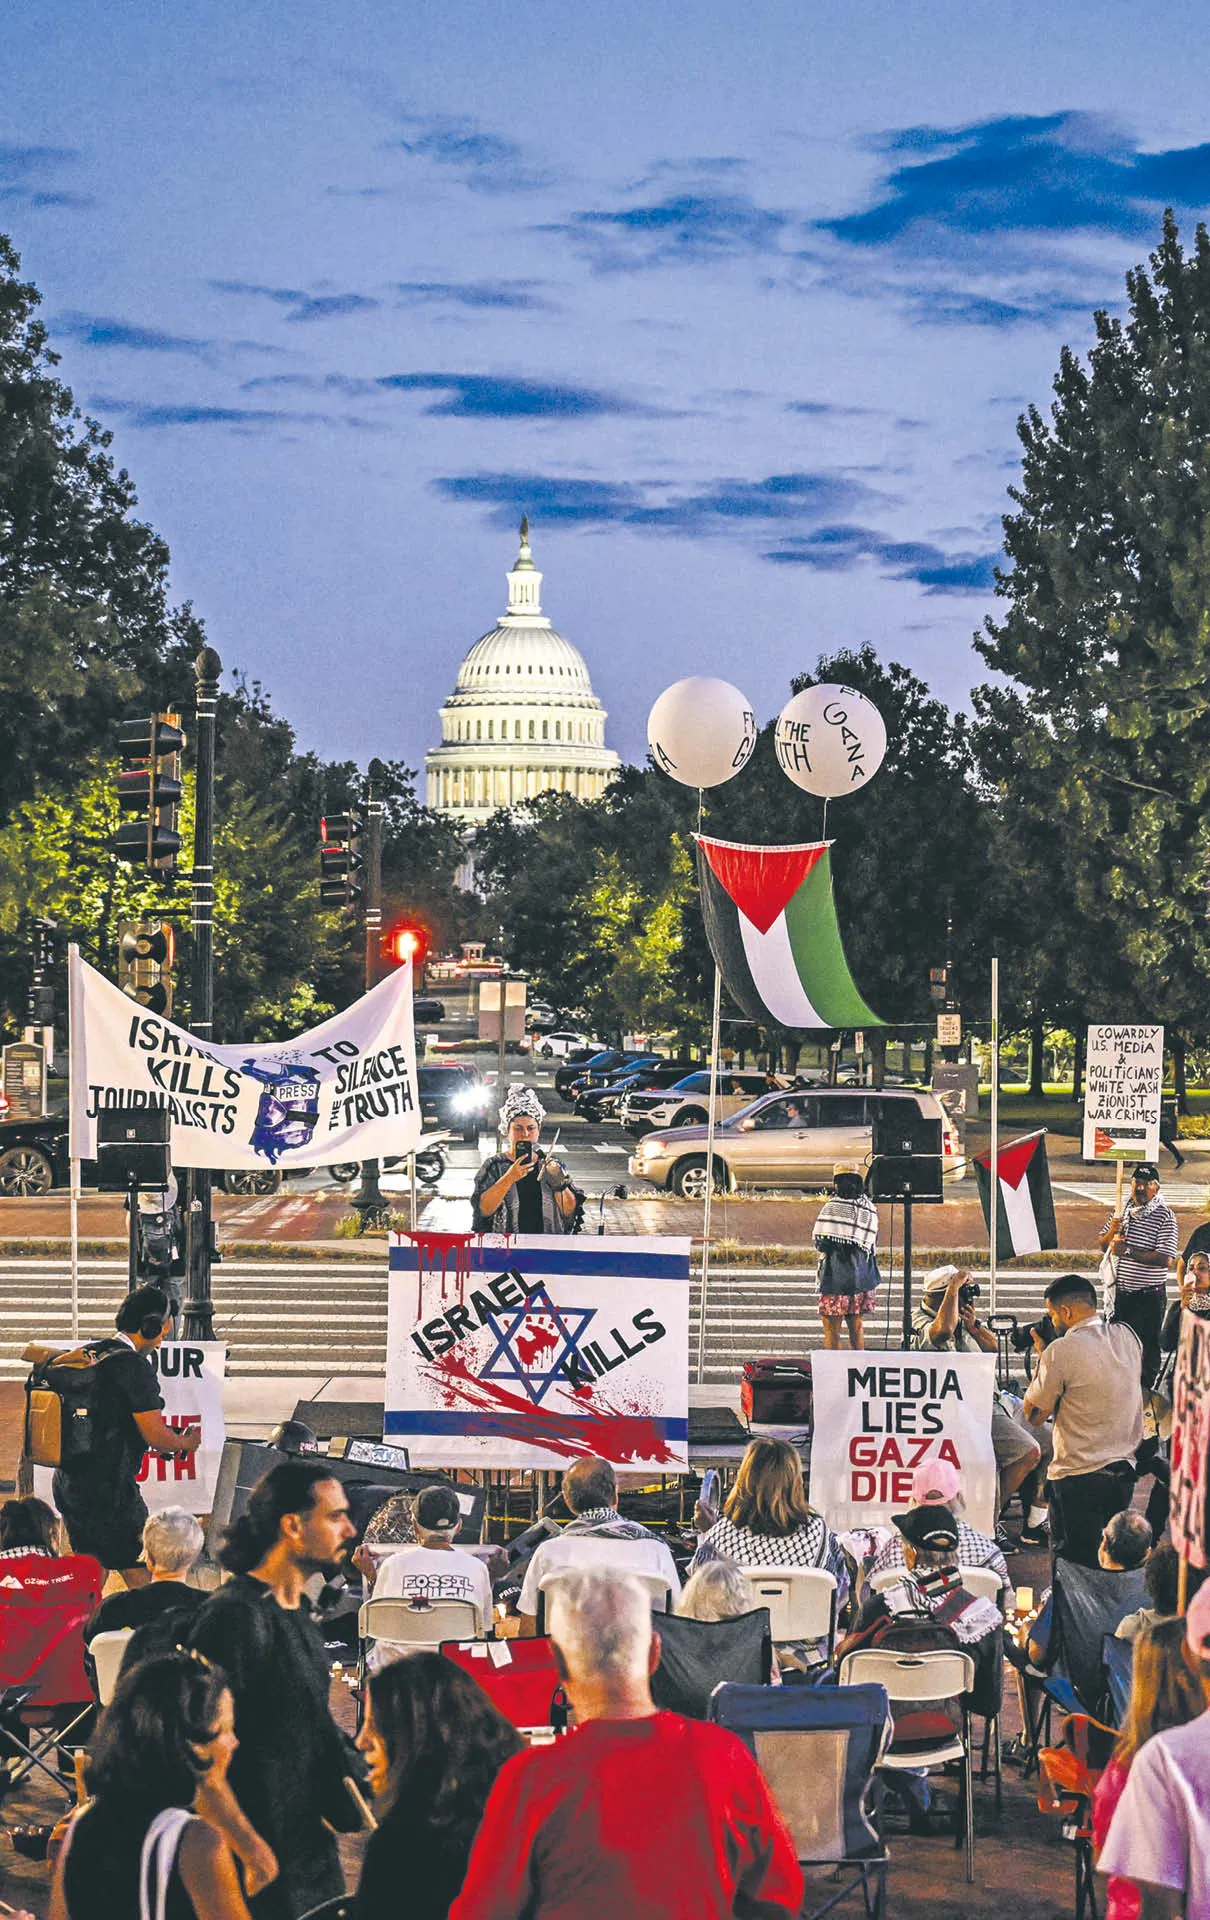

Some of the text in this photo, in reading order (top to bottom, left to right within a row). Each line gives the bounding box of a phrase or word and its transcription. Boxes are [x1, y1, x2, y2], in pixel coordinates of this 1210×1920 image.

[784, 720, 811, 742] THE
[823, 702, 865, 781] GAZA
[1097, 1027, 1160, 1039] COWARDLY
[311, 1041, 360, 1064] TO
[1118, 1053, 1127, 1065] &
[147, 1057, 242, 1098] KILLS
[335, 1045, 408, 1094] SILENCE
[279, 1085, 315, 1099] PRESS
[342, 1080, 414, 1127] TRUTH
[1130, 1082, 1158, 1094] WASH
[328, 1100, 342, 1131] THE
[1088, 1109, 1112, 1120] WAR
[410, 1267, 545, 1362] ISRAEL
[559, 1307, 666, 1391] KILLS
[847, 1367, 963, 1400] MEDIA
[862, 1401, 944, 1434] LIES
[849, 1436, 962, 1470] GAZA
[851, 1471, 914, 1503] DIE
[403, 1575, 475, 1592] FOSSIL
